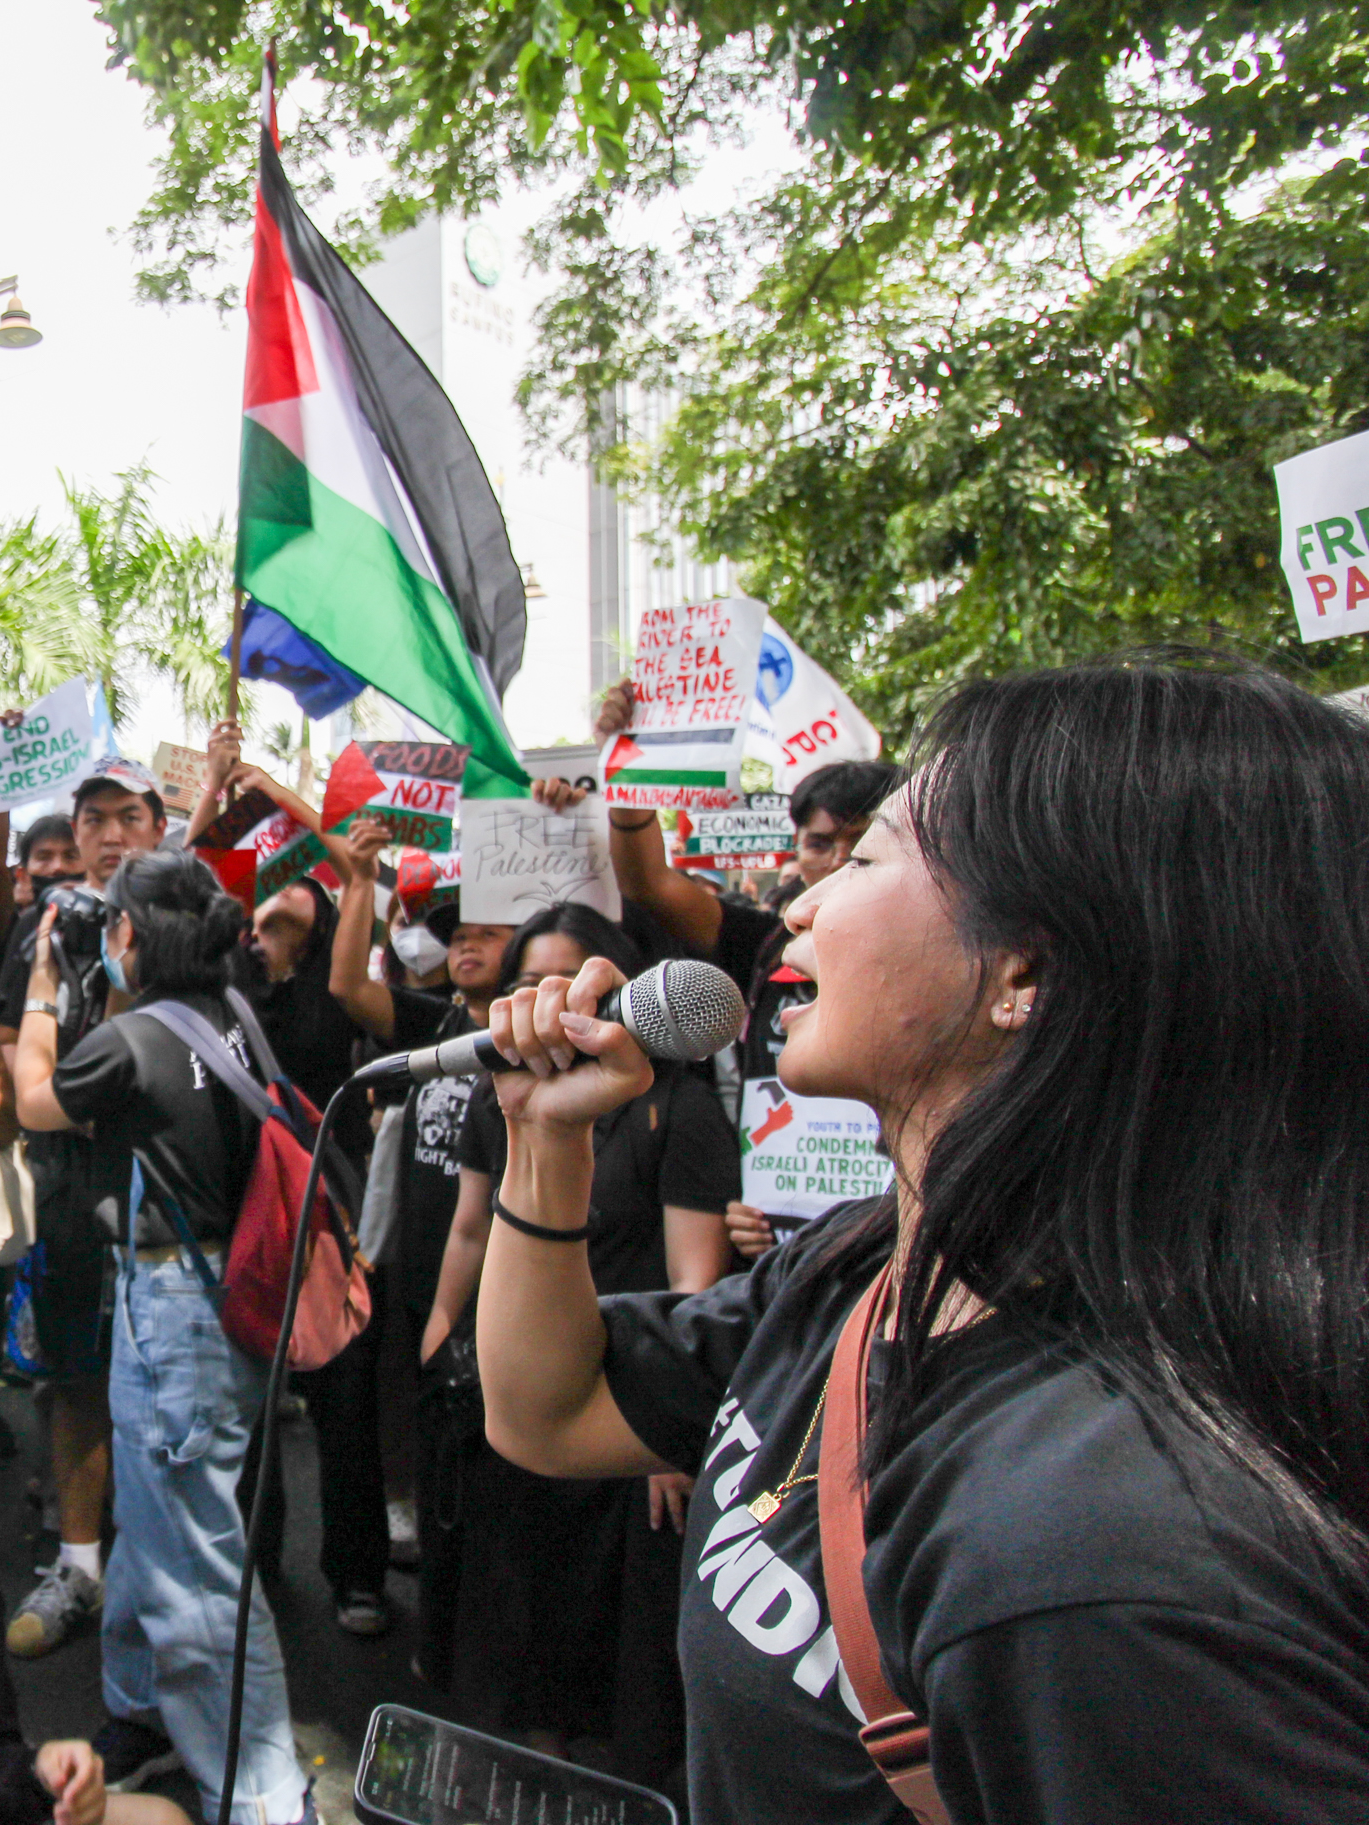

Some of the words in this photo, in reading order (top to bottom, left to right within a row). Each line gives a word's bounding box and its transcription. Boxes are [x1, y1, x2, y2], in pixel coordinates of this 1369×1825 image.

[687, 602, 723, 621] THE
[635, 653, 669, 677] THE
[680, 645, 725, 672] SEA
[3, 715, 50, 744] END
[369, 742, 471, 778] FOODS
[390, 779, 455, 813] NOT
[479, 808, 598, 849] FREE
[699, 815, 791, 834] ECONOMIC
[699, 837, 788, 854] BLOCKADE!
[473, 844, 609, 882] Palestine
[807, 1121, 841, 1133] YOUTH
[847, 1122, 862, 1133] TO
[751, 1156, 808, 1172] ISRAELI
[776, 1174, 797, 1192] ON
